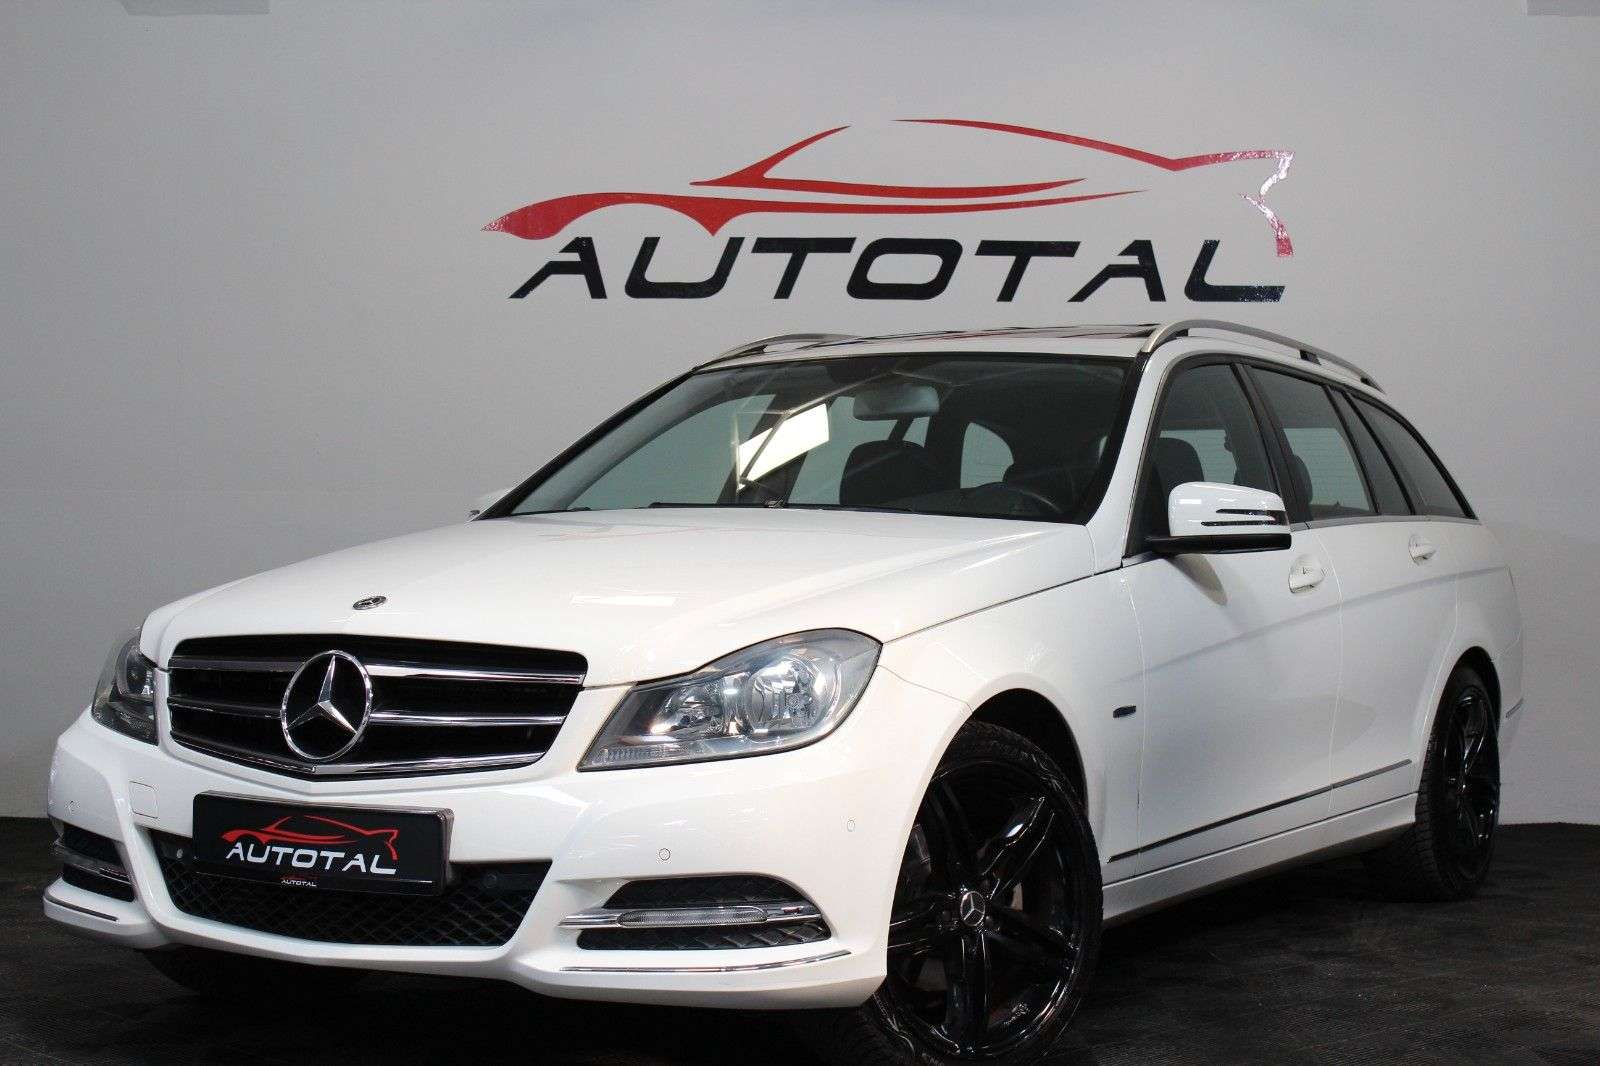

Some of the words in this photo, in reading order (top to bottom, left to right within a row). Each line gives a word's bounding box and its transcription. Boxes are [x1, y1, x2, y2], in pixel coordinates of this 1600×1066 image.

[508, 236, 1285, 303] AUTOTAL
[226, 841, 396, 875] AUTOTAL
[281, 878, 317, 887] AUTOTAL
